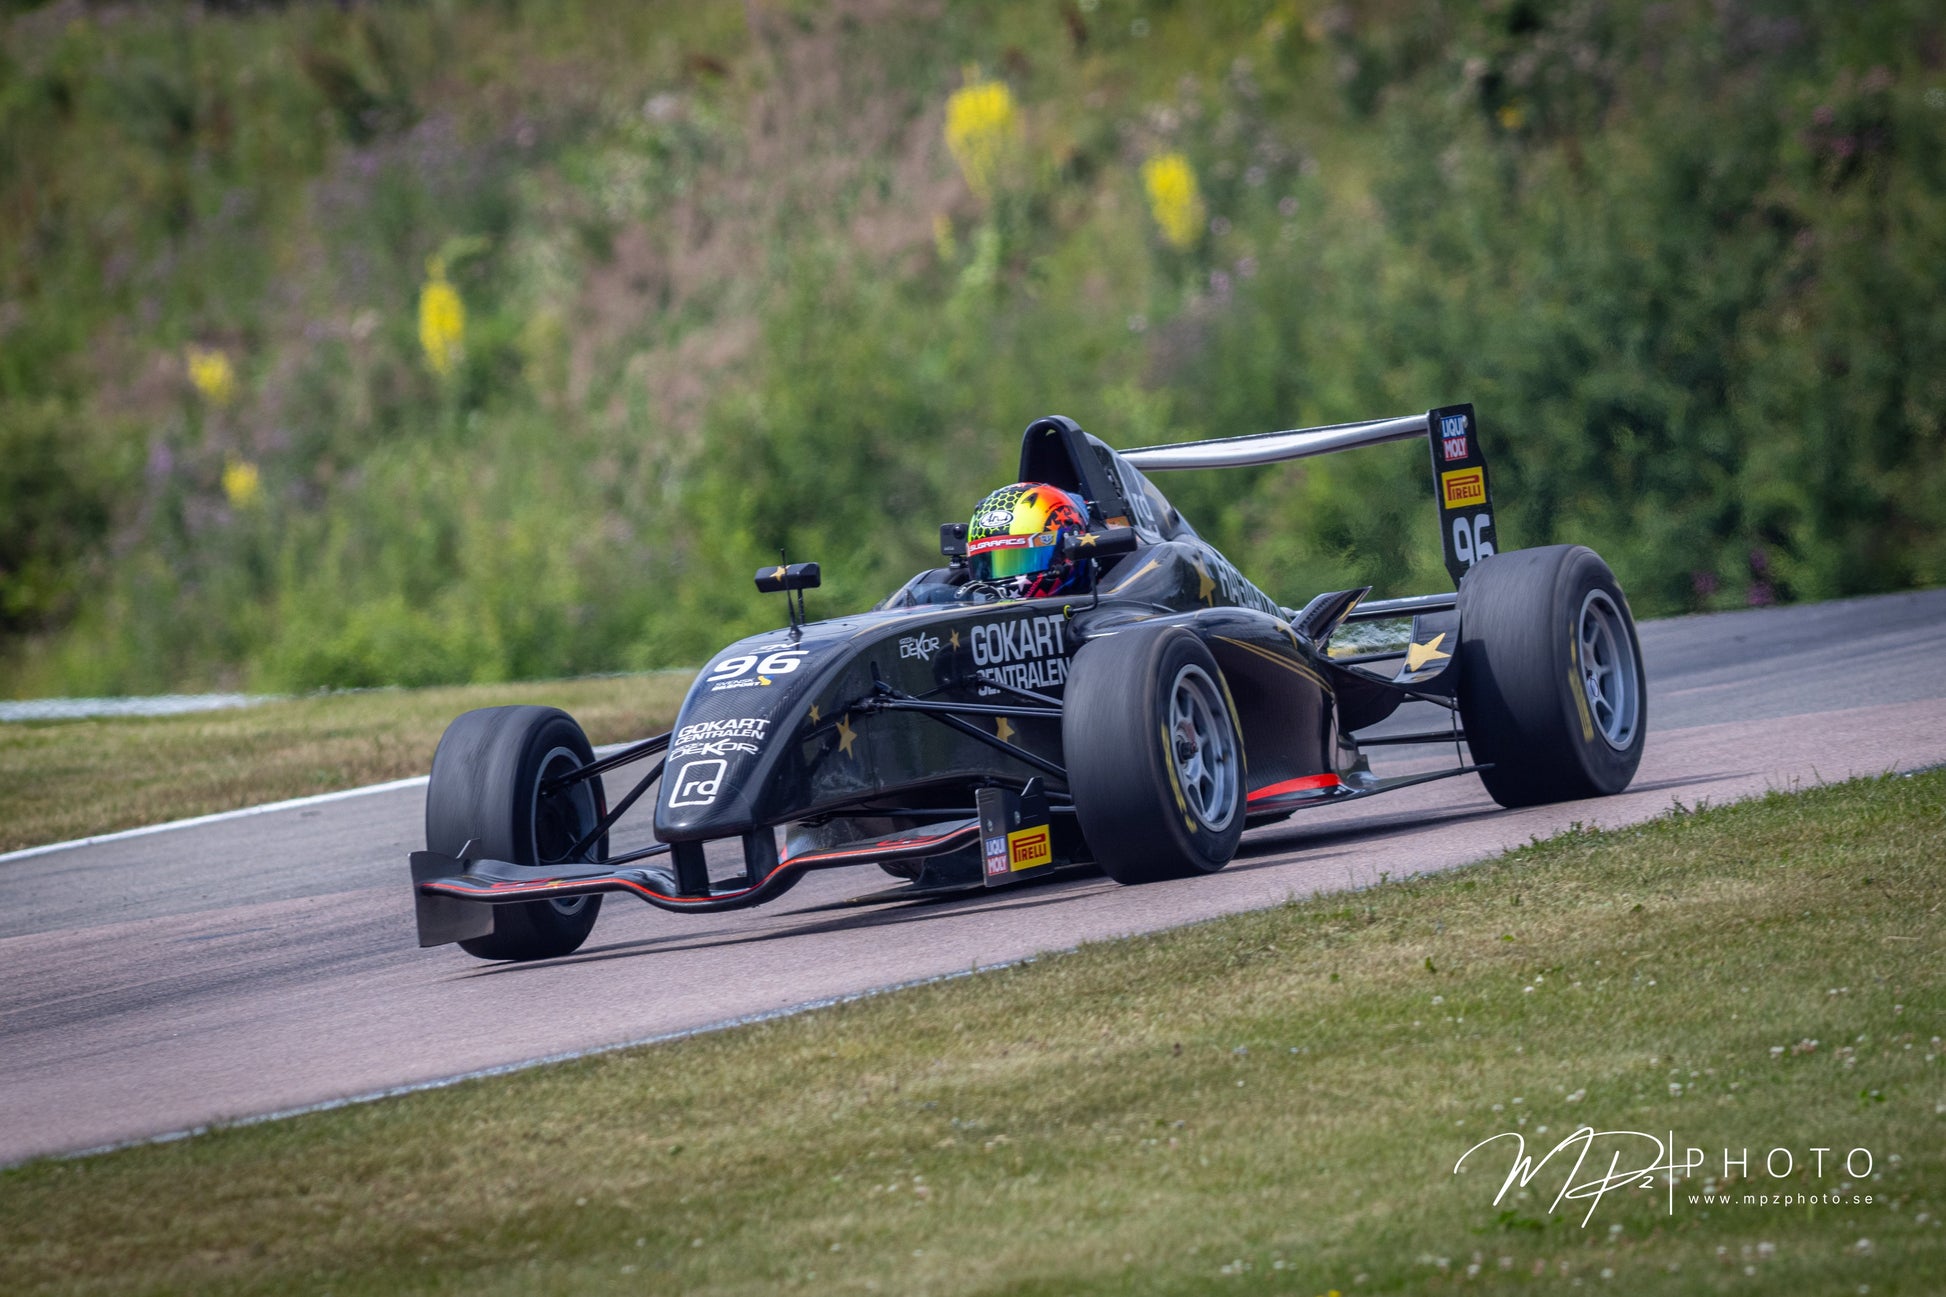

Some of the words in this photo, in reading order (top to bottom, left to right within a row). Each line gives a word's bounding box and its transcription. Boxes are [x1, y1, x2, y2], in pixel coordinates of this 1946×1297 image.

[1442, 416, 1466, 438] LIQUI
[1444, 438, 1467, 459] MOLY
[1446, 474, 1482, 501] PIRELLI
[1453, 513, 1495, 581] 96
[899, 632, 940, 661] DEKOR
[970, 614, 1066, 666] GOKART
[706, 650, 810, 682] 96
[674, 728, 766, 747] CENTRALEN
[678, 718, 771, 739] GOKART
[668, 738, 760, 762] DEKOR
[985, 838, 1006, 856] LIQUI
[1012, 833, 1047, 864] PIRELLI
[987, 855, 1008, 874] MOLY
